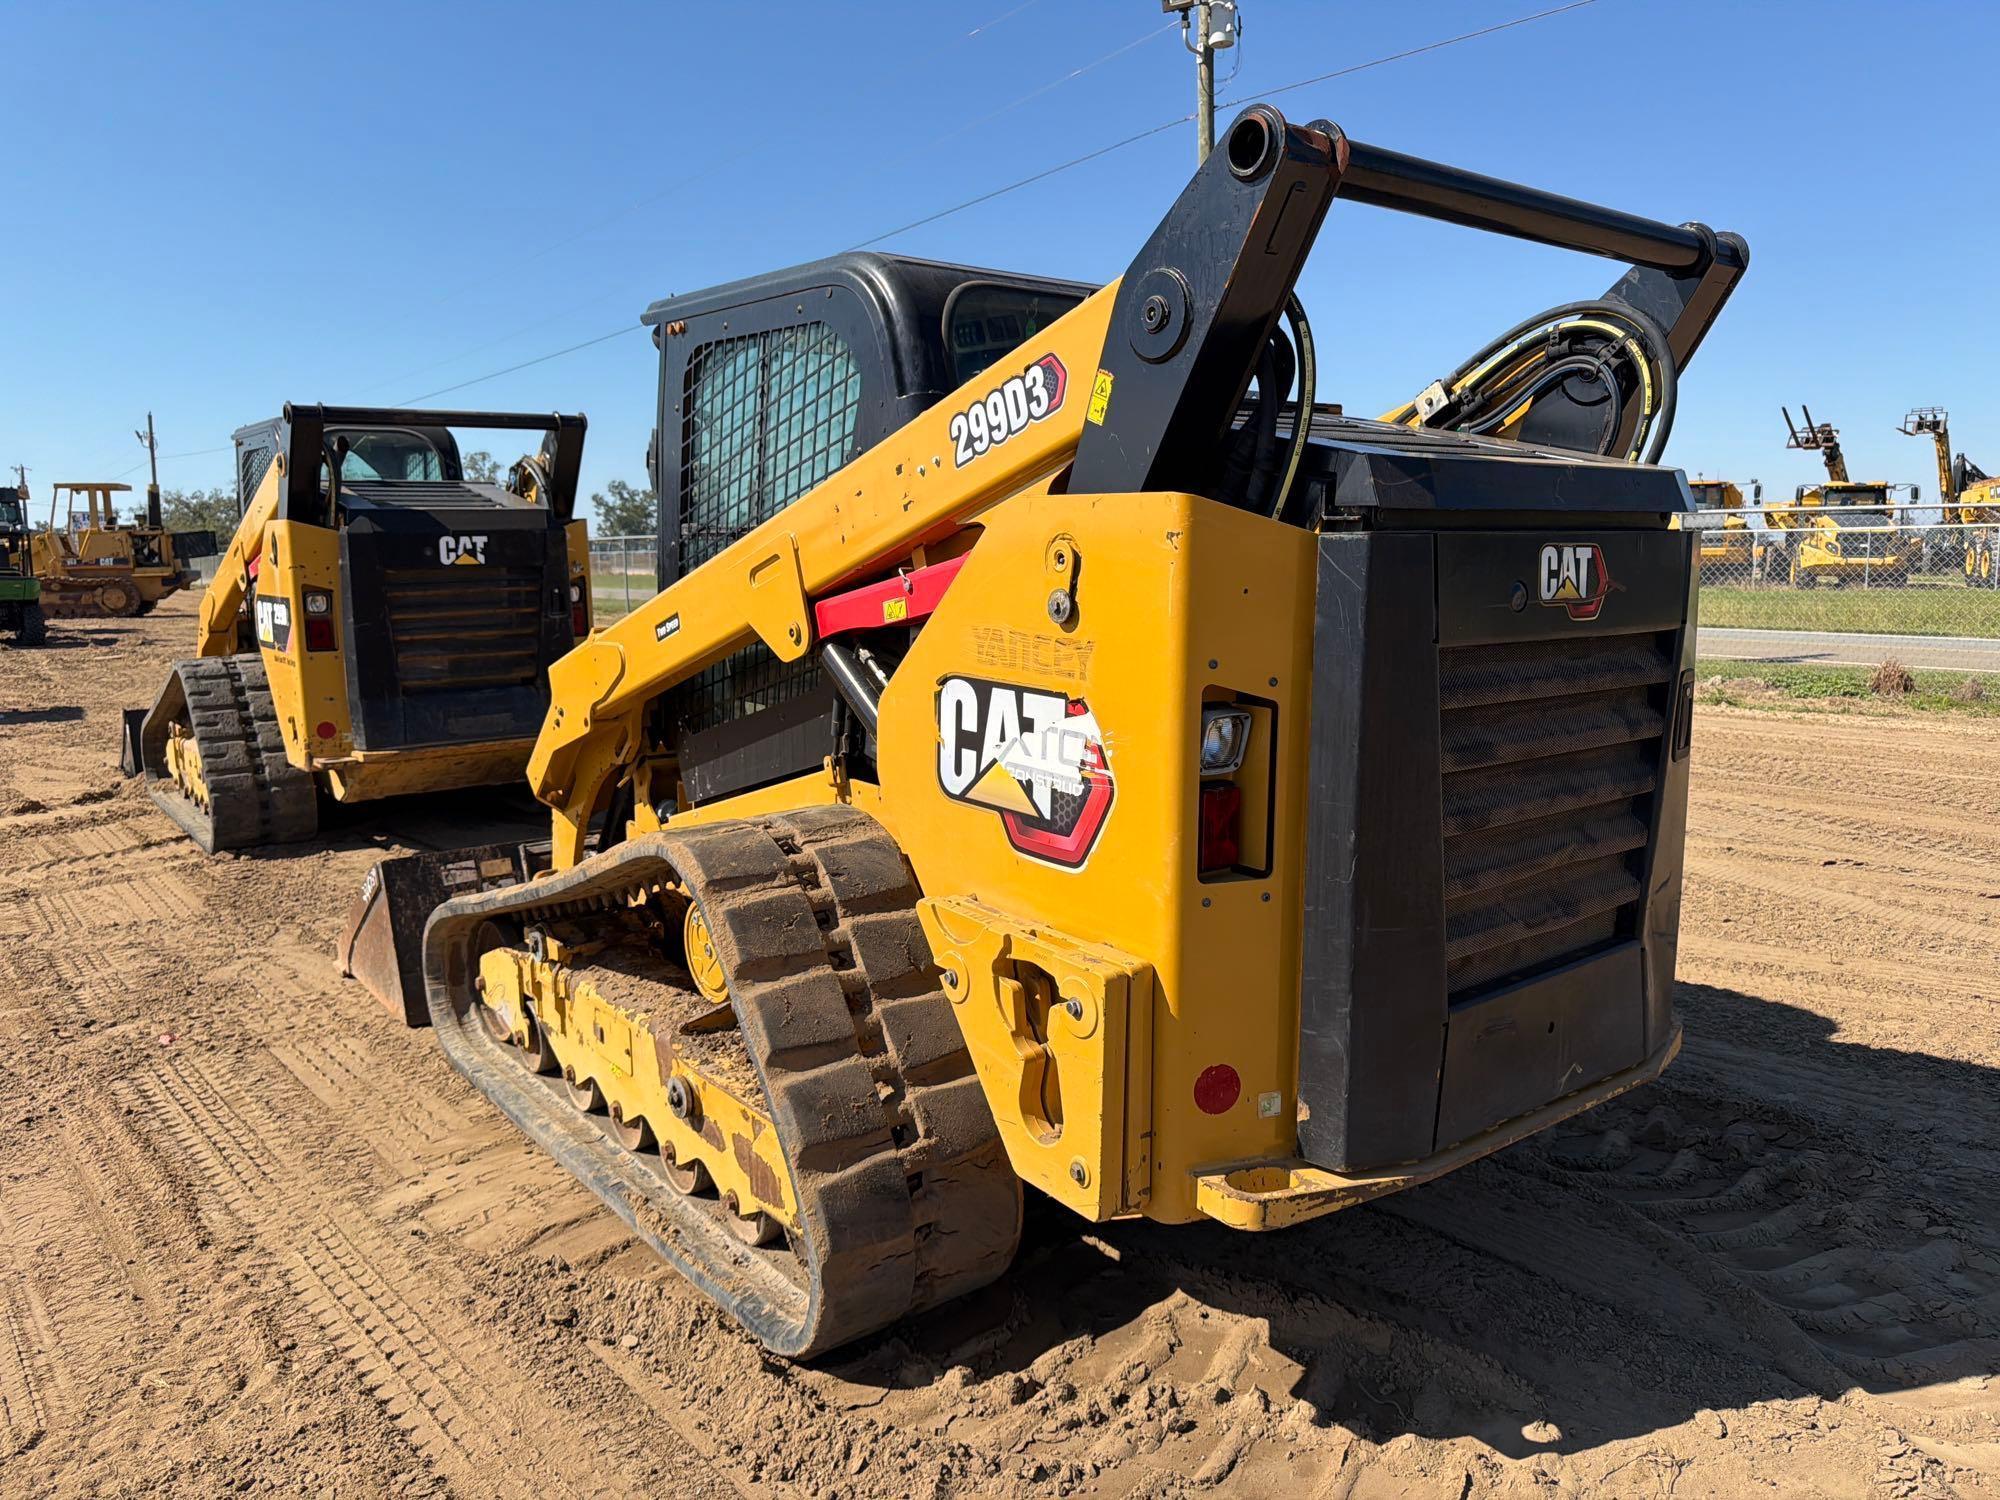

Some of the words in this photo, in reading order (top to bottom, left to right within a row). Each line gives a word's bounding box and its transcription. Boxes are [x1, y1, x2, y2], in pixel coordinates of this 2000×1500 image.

[951, 365, 1049, 465] 299D3
[439, 535, 488, 566] CAT
[1540, 546, 1593, 600] CAT
[940, 678, 1066, 821] CAT
